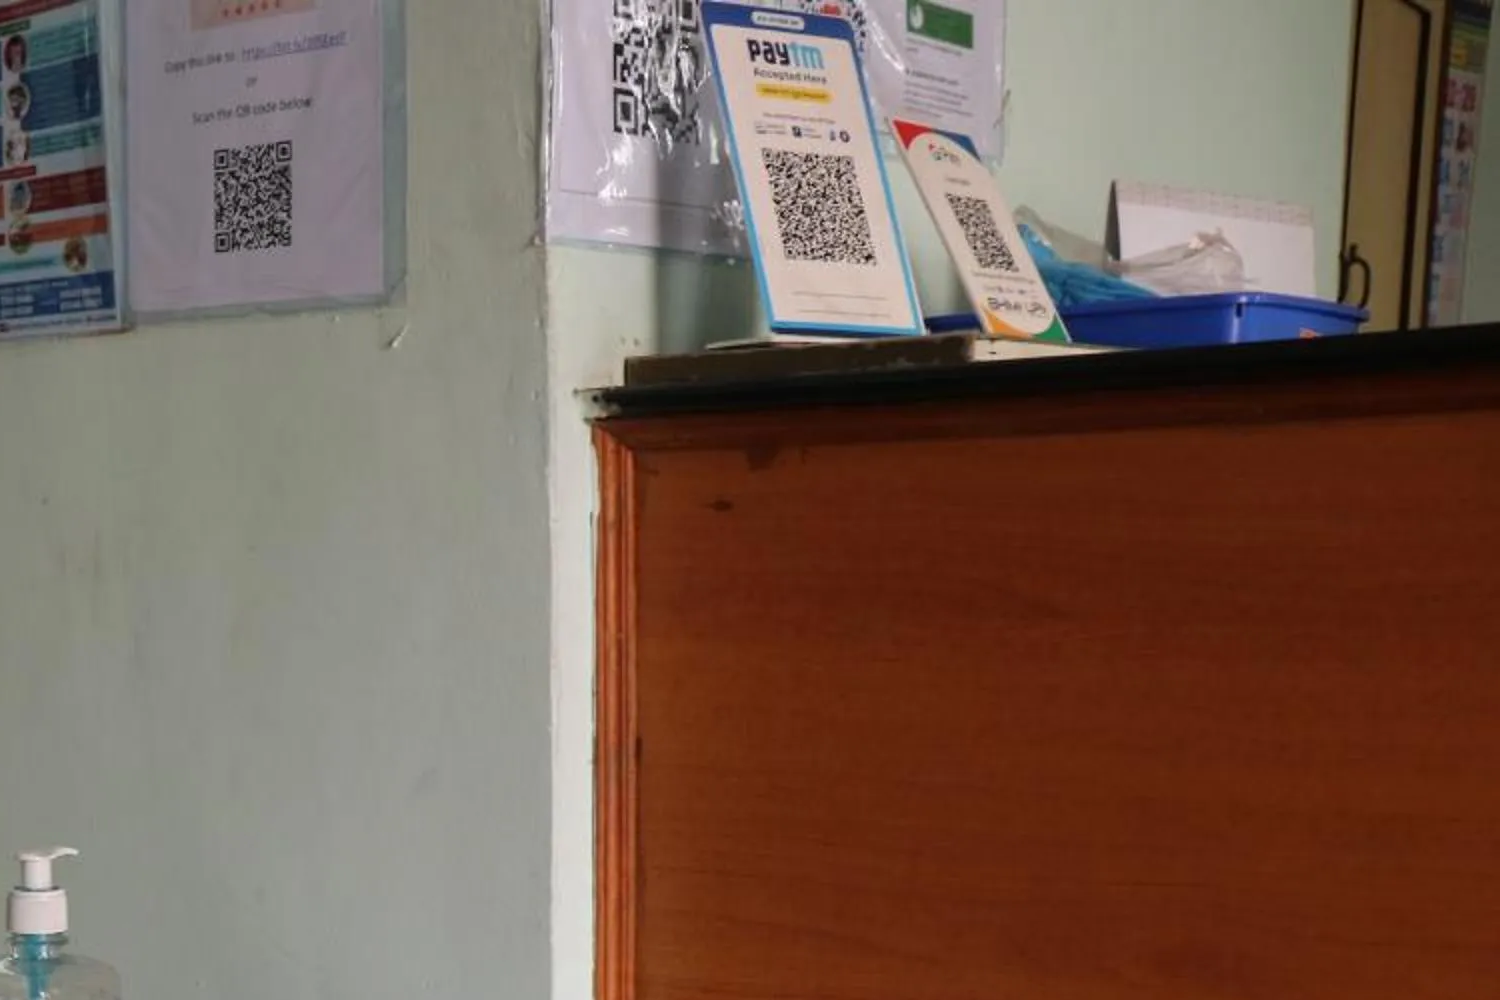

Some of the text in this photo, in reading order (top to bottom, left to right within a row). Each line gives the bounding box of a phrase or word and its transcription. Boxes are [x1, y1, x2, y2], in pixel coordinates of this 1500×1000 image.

[753, 68, 828, 84] Accepted Here
[191, 96, 314, 125] Scan the QR code below
